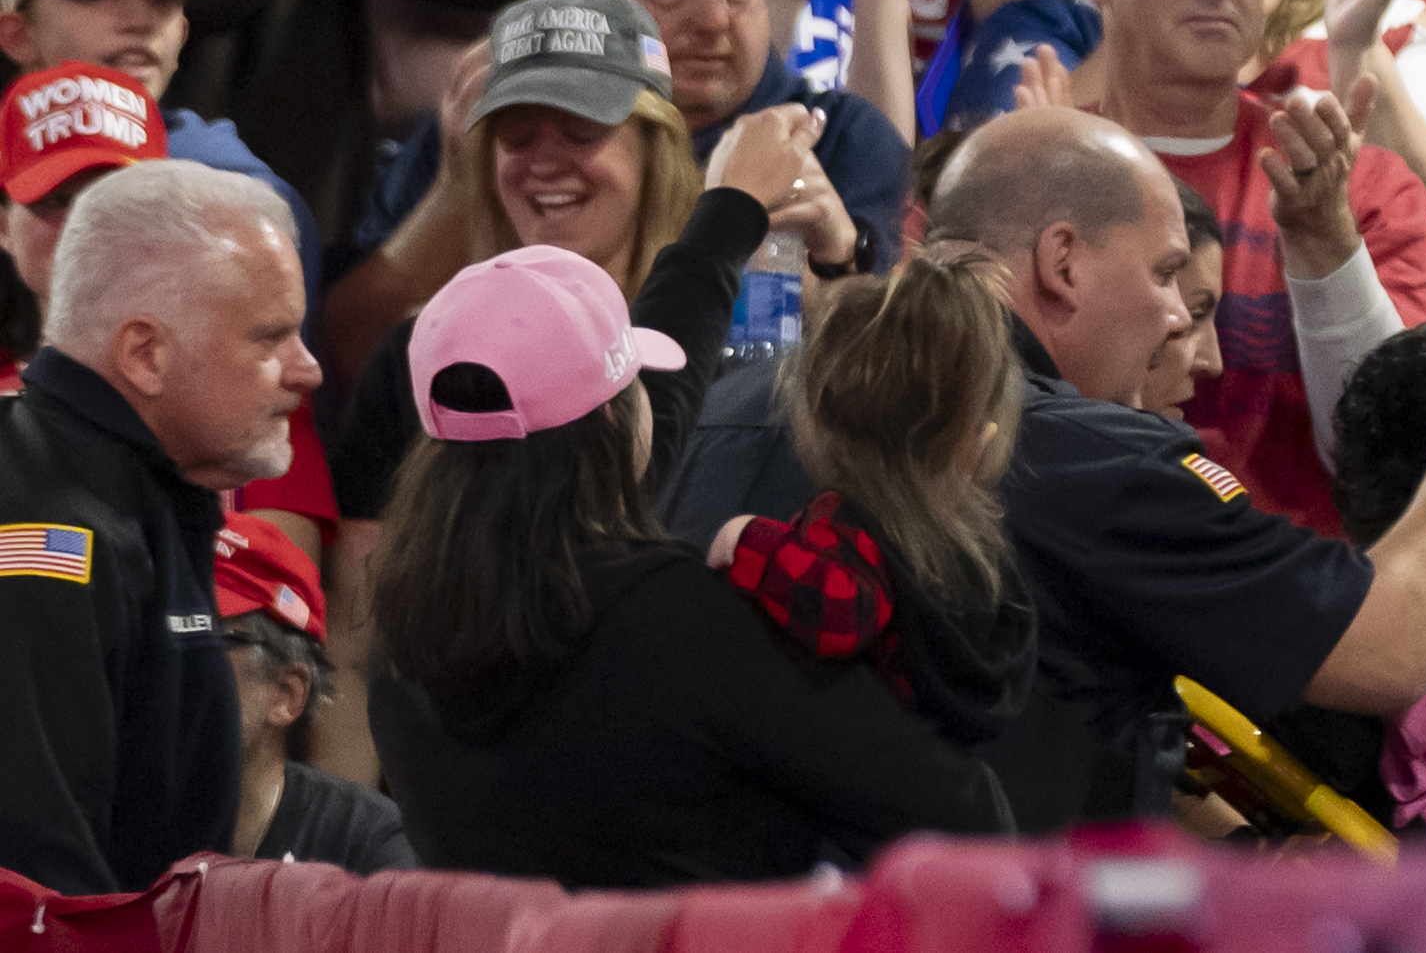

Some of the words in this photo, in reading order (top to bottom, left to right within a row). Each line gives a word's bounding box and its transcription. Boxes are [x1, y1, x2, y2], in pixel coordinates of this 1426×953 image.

[536, 6, 611, 35] AMERICA
[549, 29, 605, 57] AGAIN
[18, 74, 148, 122] WOMEN
[25, 103, 148, 152] TRUMP
